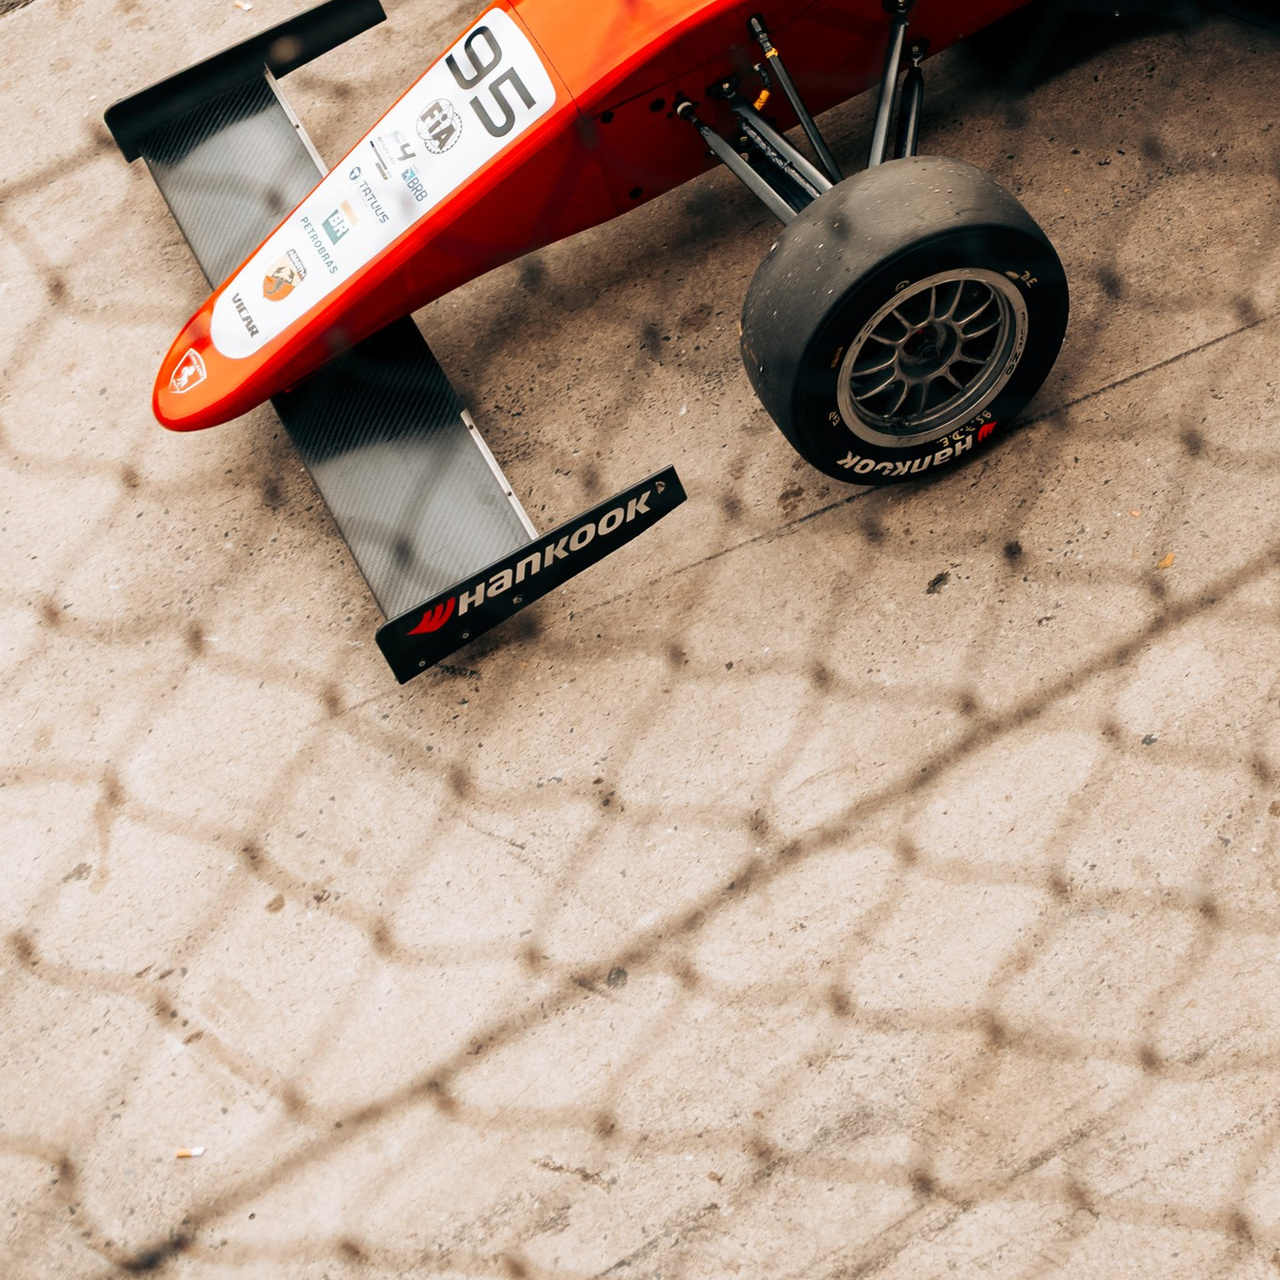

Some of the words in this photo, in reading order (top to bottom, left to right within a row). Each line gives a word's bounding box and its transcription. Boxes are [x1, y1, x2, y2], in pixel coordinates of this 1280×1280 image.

[445, 25, 537, 138] 95
[359, 180, 389, 224] TATUUS
[406, 176, 428, 202] BRB
[300, 216, 338, 274] PETROBRAS
[231, 292, 260, 338] VICAR
